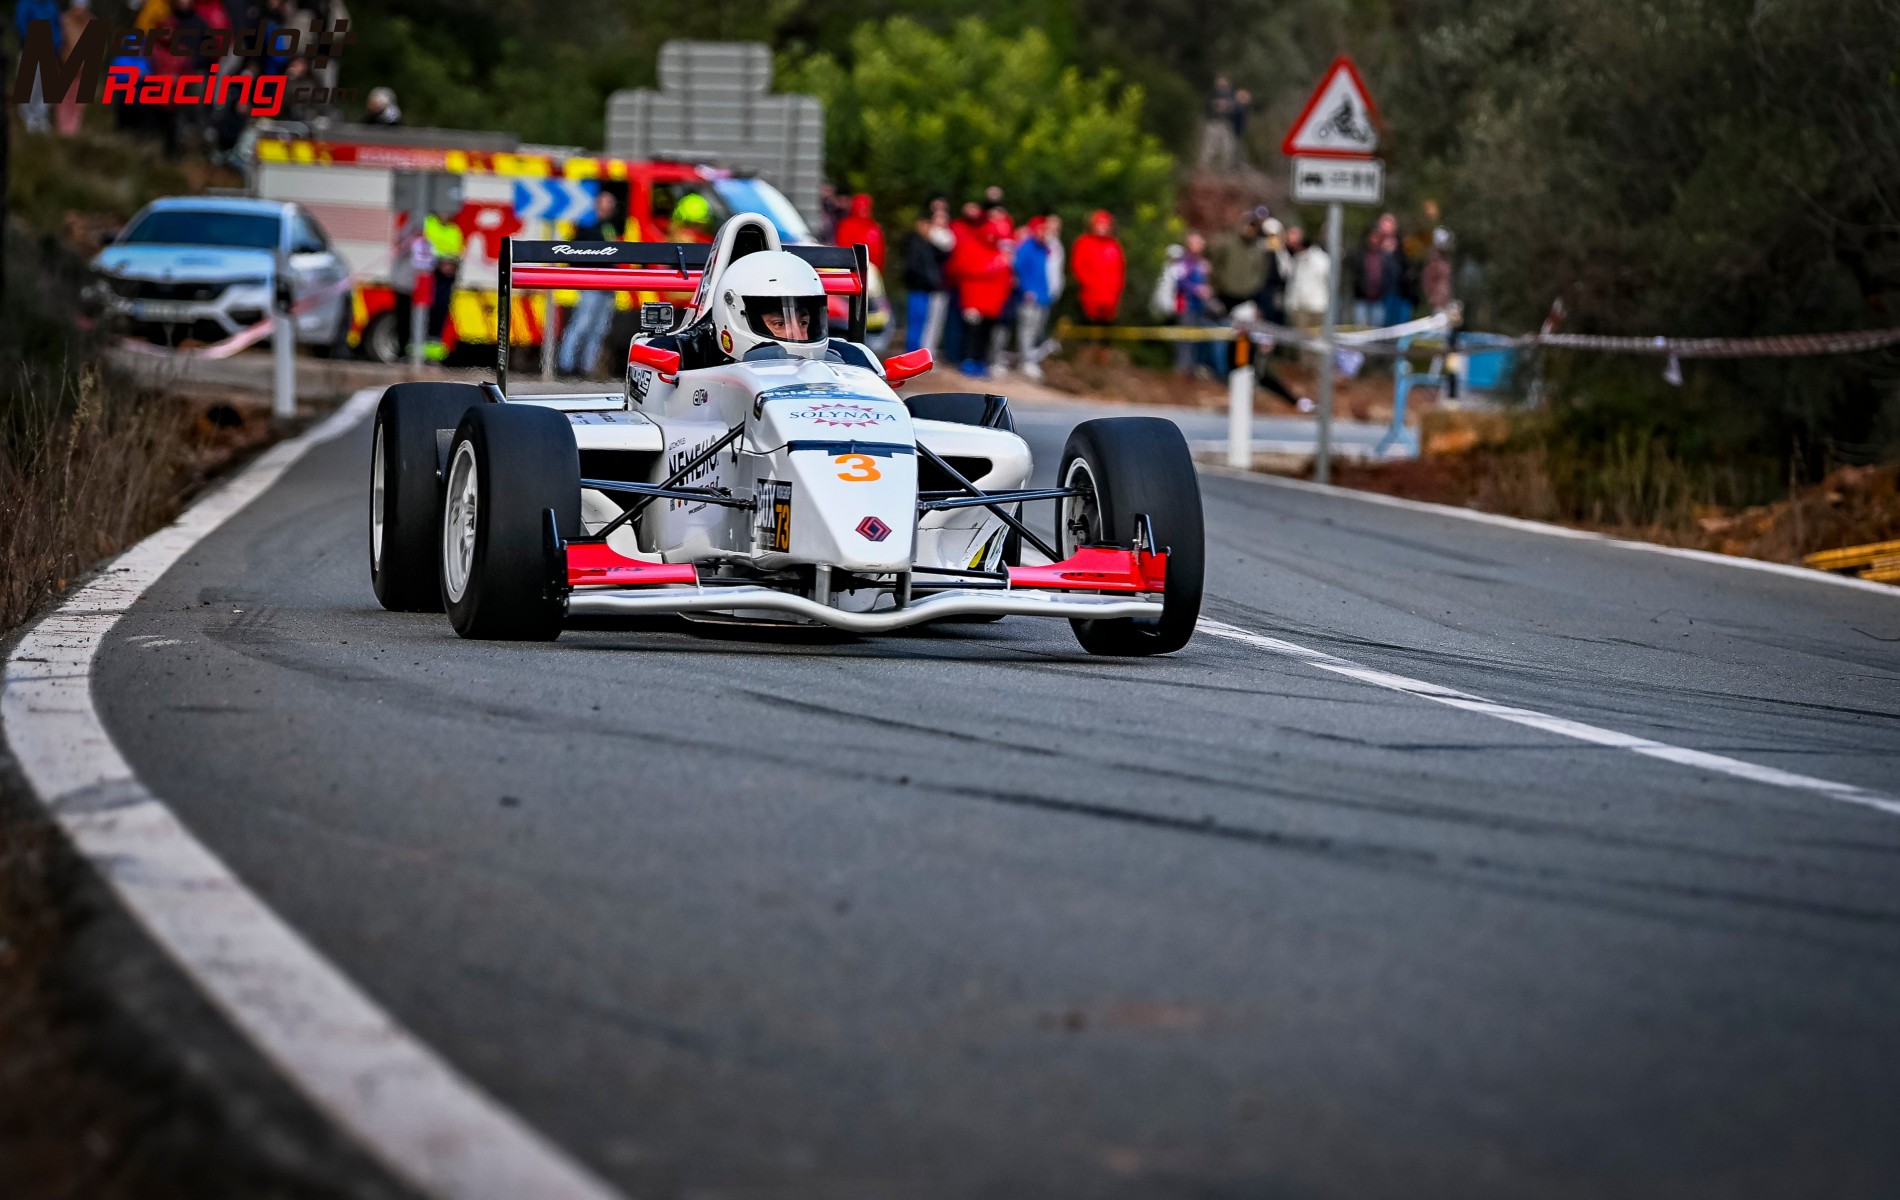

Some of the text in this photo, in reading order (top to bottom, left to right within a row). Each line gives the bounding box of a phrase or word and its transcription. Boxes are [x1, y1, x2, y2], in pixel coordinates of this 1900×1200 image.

[551, 244, 619, 256] Renault
[790, 411, 897, 421] SOLYNATA
[834, 453, 882, 482] 3
[775, 504, 790, 550] 73
